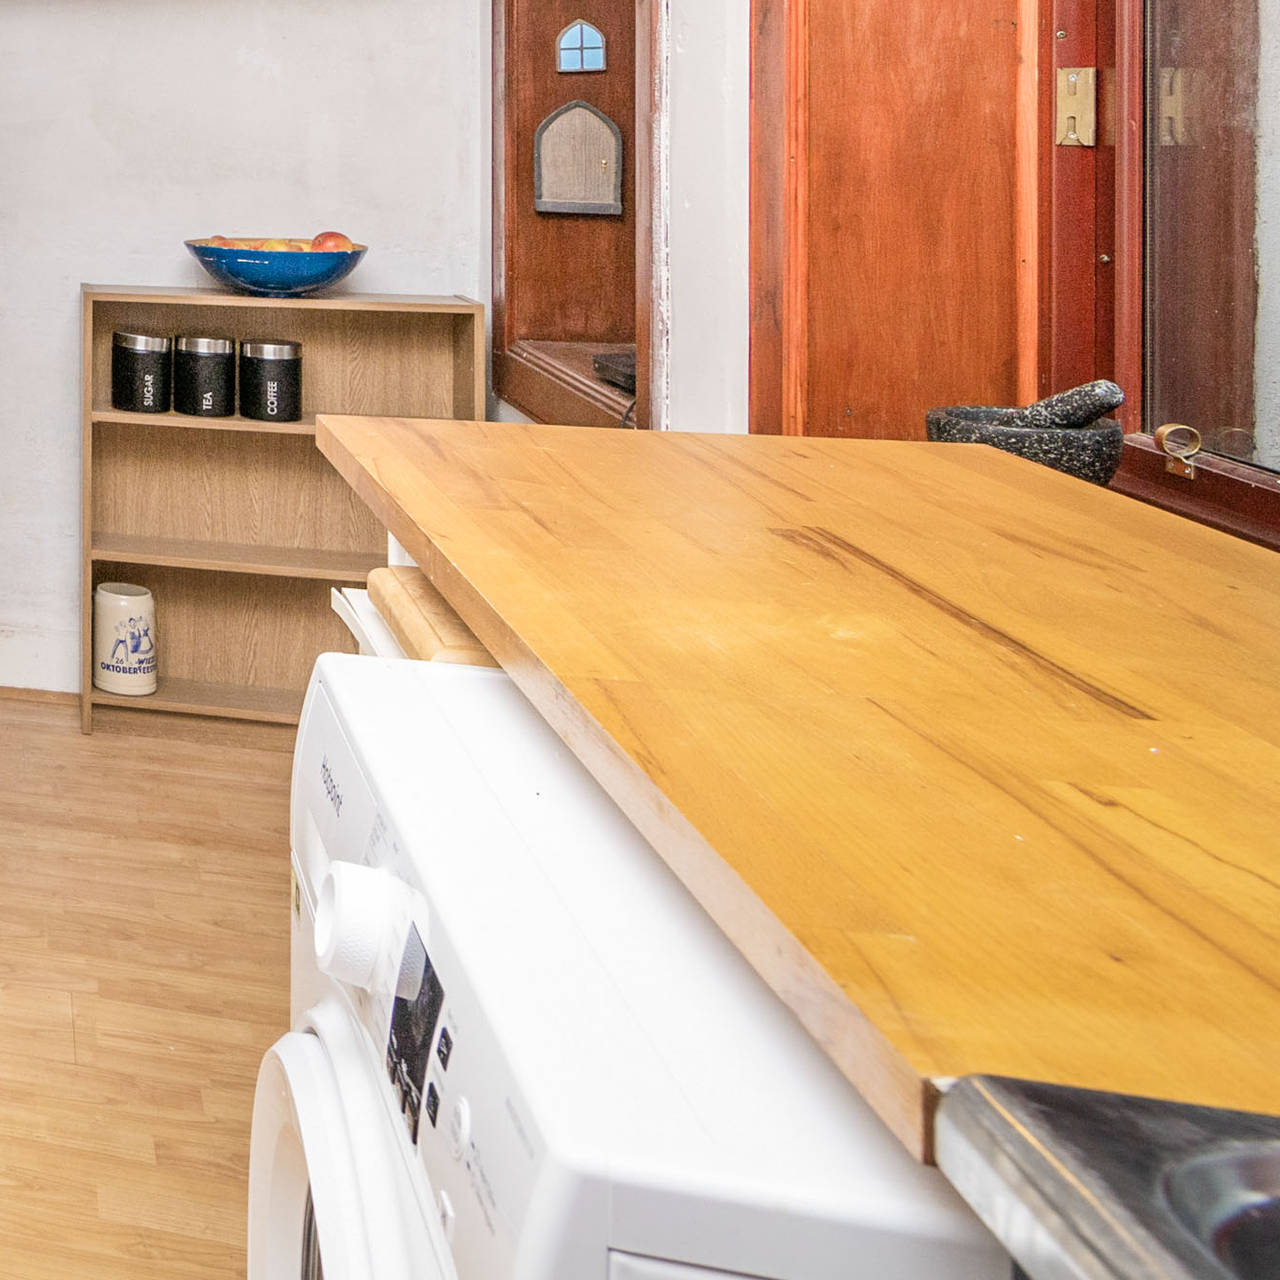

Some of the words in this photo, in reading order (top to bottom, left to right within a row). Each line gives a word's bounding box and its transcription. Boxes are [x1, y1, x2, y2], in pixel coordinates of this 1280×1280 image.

[143, 374, 154, 406] SUGAR
[202, 392, 213, 410] TEA
[267, 381, 278, 415] COFFEE
